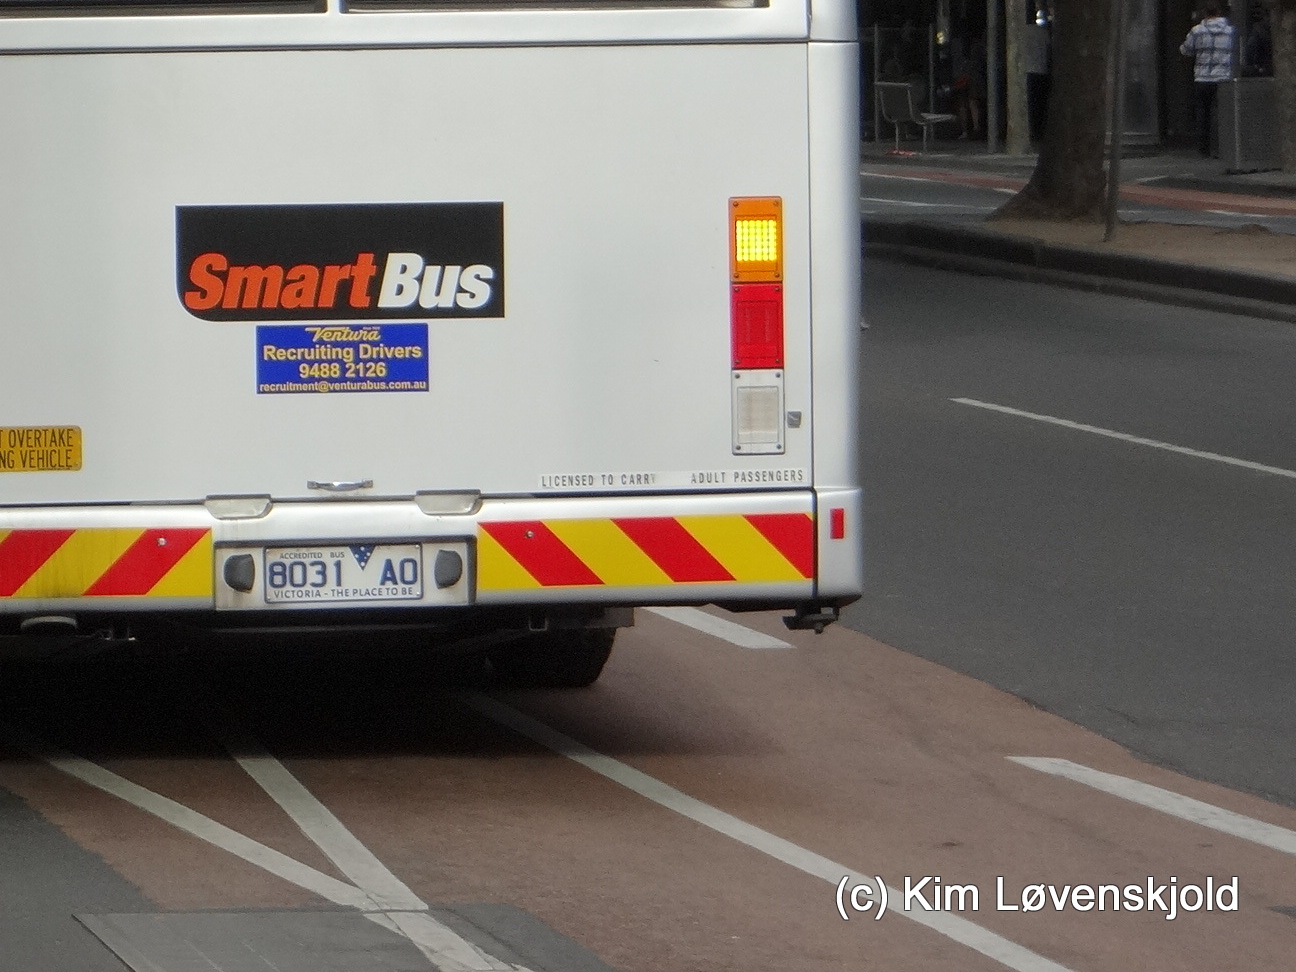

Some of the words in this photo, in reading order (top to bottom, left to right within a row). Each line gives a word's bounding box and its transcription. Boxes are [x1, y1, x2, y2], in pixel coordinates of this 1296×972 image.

[305, 327, 381, 342] Ventura
[263, 344, 354, 362] Recruiting
[359, 343, 422, 359] Drivers
[299, 363, 340, 378] 9488
[345, 362, 386, 377] 2126
[259, 380, 426, 393] recruitment@venturabus.com.au
[8, 428, 74, 448] OVERTAKE
[20, 449, 73, 468] VEHICLE
[541, 475, 594, 487] LICENSED
[601, 474, 614, 485] TO
[690, 471, 726, 484] ADULT
[733, 469, 803, 483] PASSENGERS
[330, 551, 345, 559] BUS
[268, 559, 342, 588] 8031
[273, 588, 321, 599] VICTORIA
[331, 588, 349, 597] THE
[352, 587, 383, 597] PLACE
[385, 587, 398, 596] TO
[401, 587, 413, 595] BE
